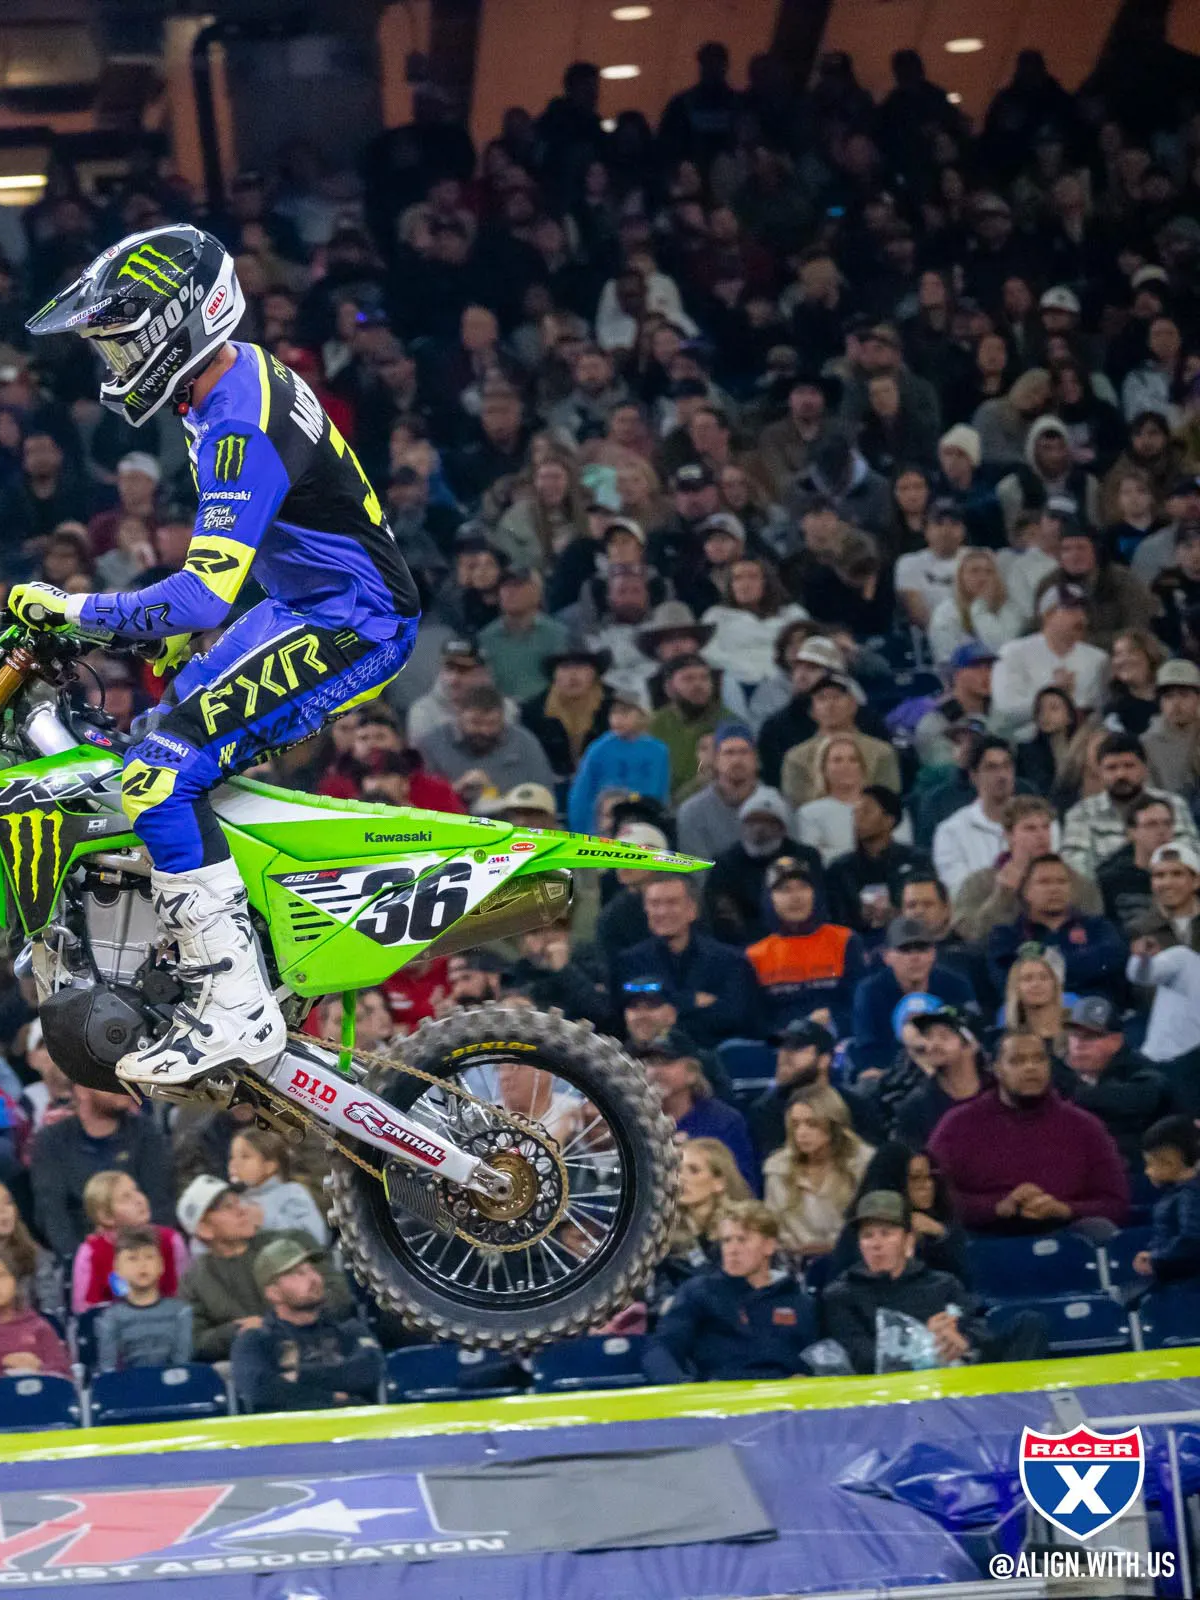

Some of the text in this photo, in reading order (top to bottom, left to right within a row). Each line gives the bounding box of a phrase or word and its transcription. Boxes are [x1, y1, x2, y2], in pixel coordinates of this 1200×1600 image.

[135, 276, 204, 354] 100%
[208, 291, 225, 316] BELL
[138, 347, 183, 394] MONSTER
[200, 633, 328, 735] FXR
[365, 832, 432, 842] Kawasaki
[576, 849, 648, 860] DUNLOP
[356, 862, 473, 946] 36
[154, 1538, 506, 1576] ASSOCIATION
